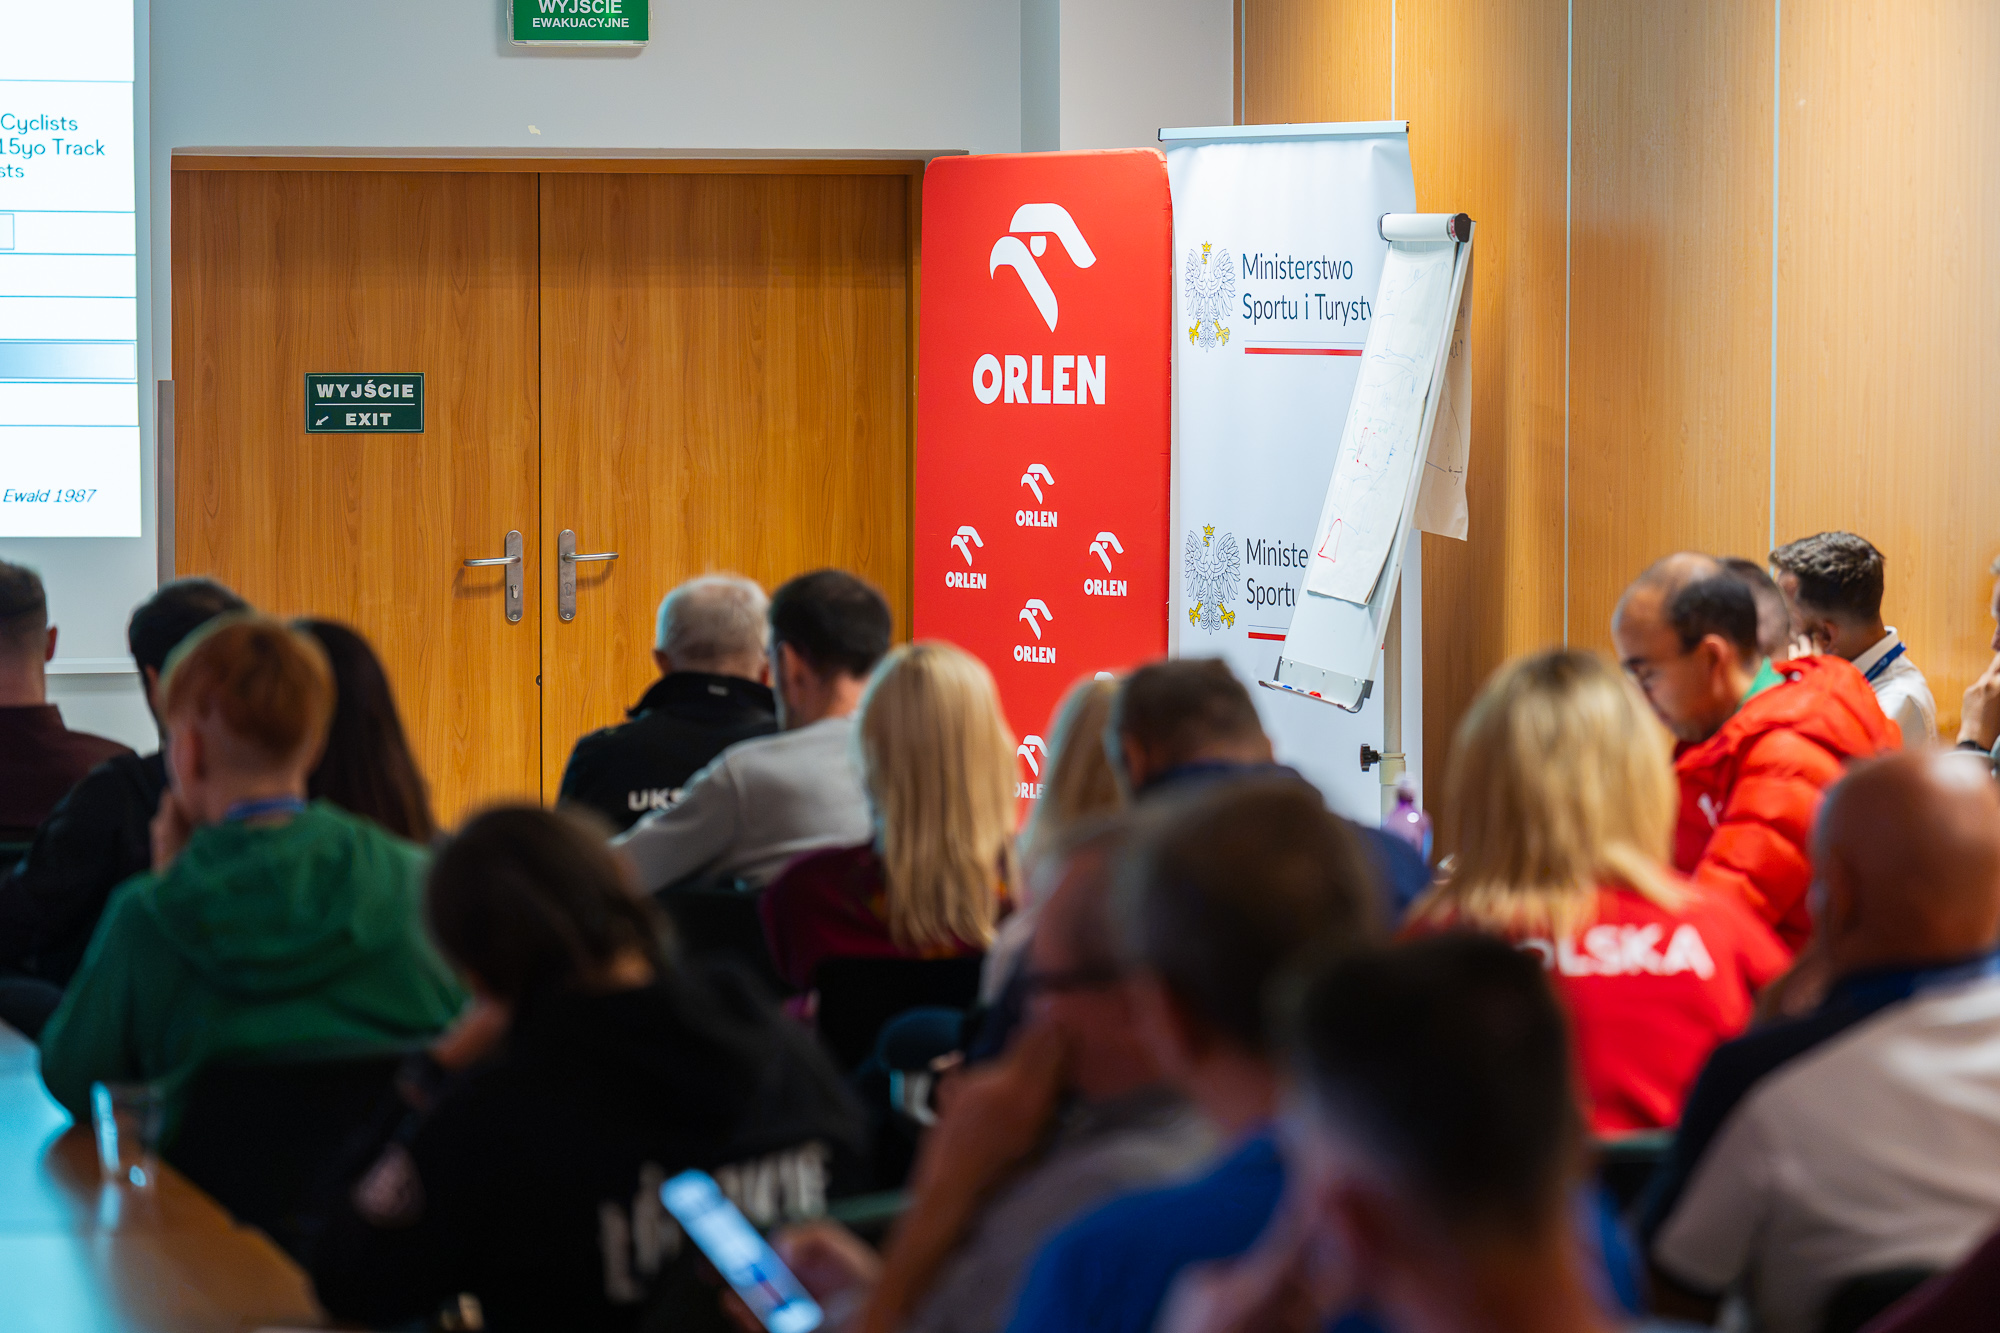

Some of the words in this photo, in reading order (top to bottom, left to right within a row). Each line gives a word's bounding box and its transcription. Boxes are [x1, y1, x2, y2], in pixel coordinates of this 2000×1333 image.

[532, 17, 630, 28] EWAKUACYJNE
[0, 113, 79, 135] Cyclists
[51, 138, 106, 156] Track
[1242, 252, 1354, 281] Ministerstwo
[1242, 292, 1298, 326] Sportu
[1304, 292, 1309, 321] i
[316, 379, 414, 398] WYJŚCIE
[972, 353, 1106, 405] ORLEN
[345, 412, 392, 426] EXIT
[3, 488, 51, 503] Ewald
[53, 488, 98, 503] 1987
[1015, 509, 1058, 528] ORLEN
[1246, 538, 1309, 569] Ministe
[945, 571, 987, 590] ORLEN
[1083, 578, 1128, 597] ORLEN
[1013, 644, 1056, 664] ORLEN
[1013, 781, 1046, 800] ORLE
